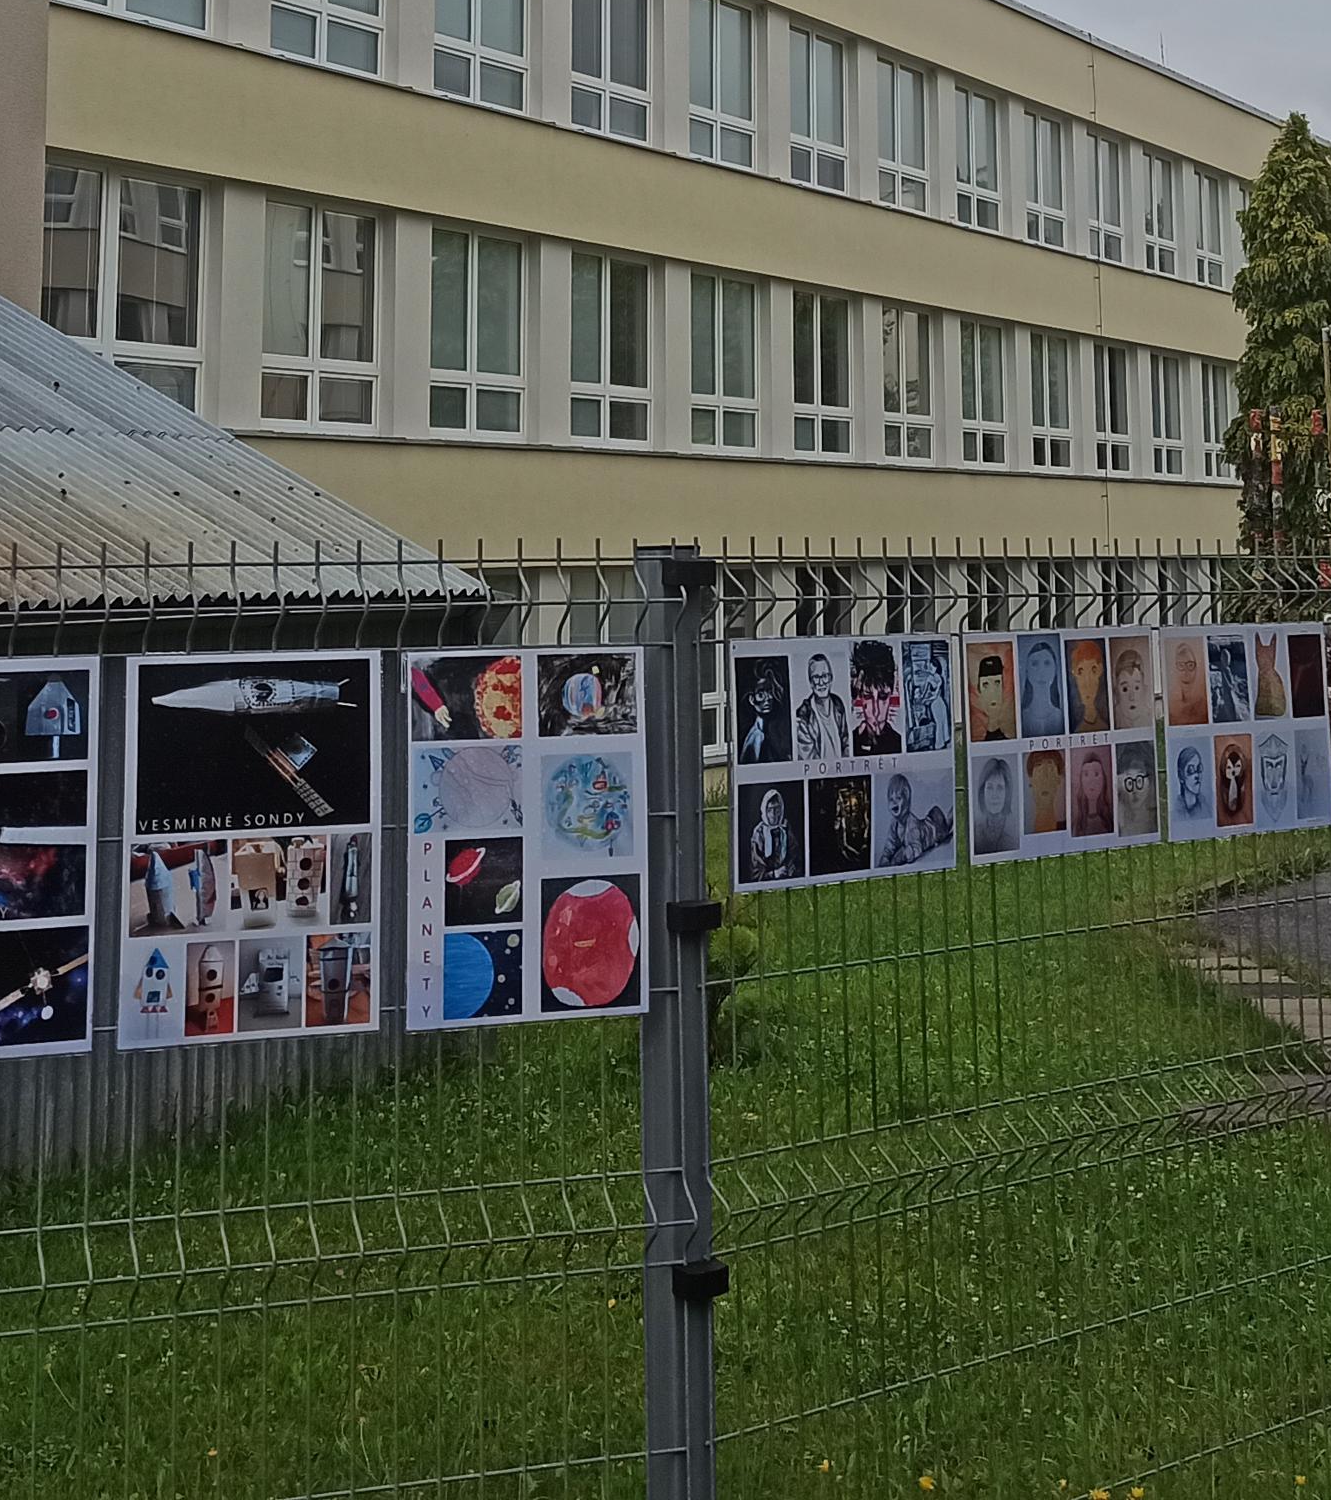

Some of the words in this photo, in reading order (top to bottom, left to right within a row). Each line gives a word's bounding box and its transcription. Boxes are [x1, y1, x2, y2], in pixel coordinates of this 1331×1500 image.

[803, 756, 898, 775] PORTRÉT
[138, 812, 233, 832] VESMÍRNÉ
[243, 812, 305, 827] SONDY
[421, 842, 433, 1019] PLANETY
